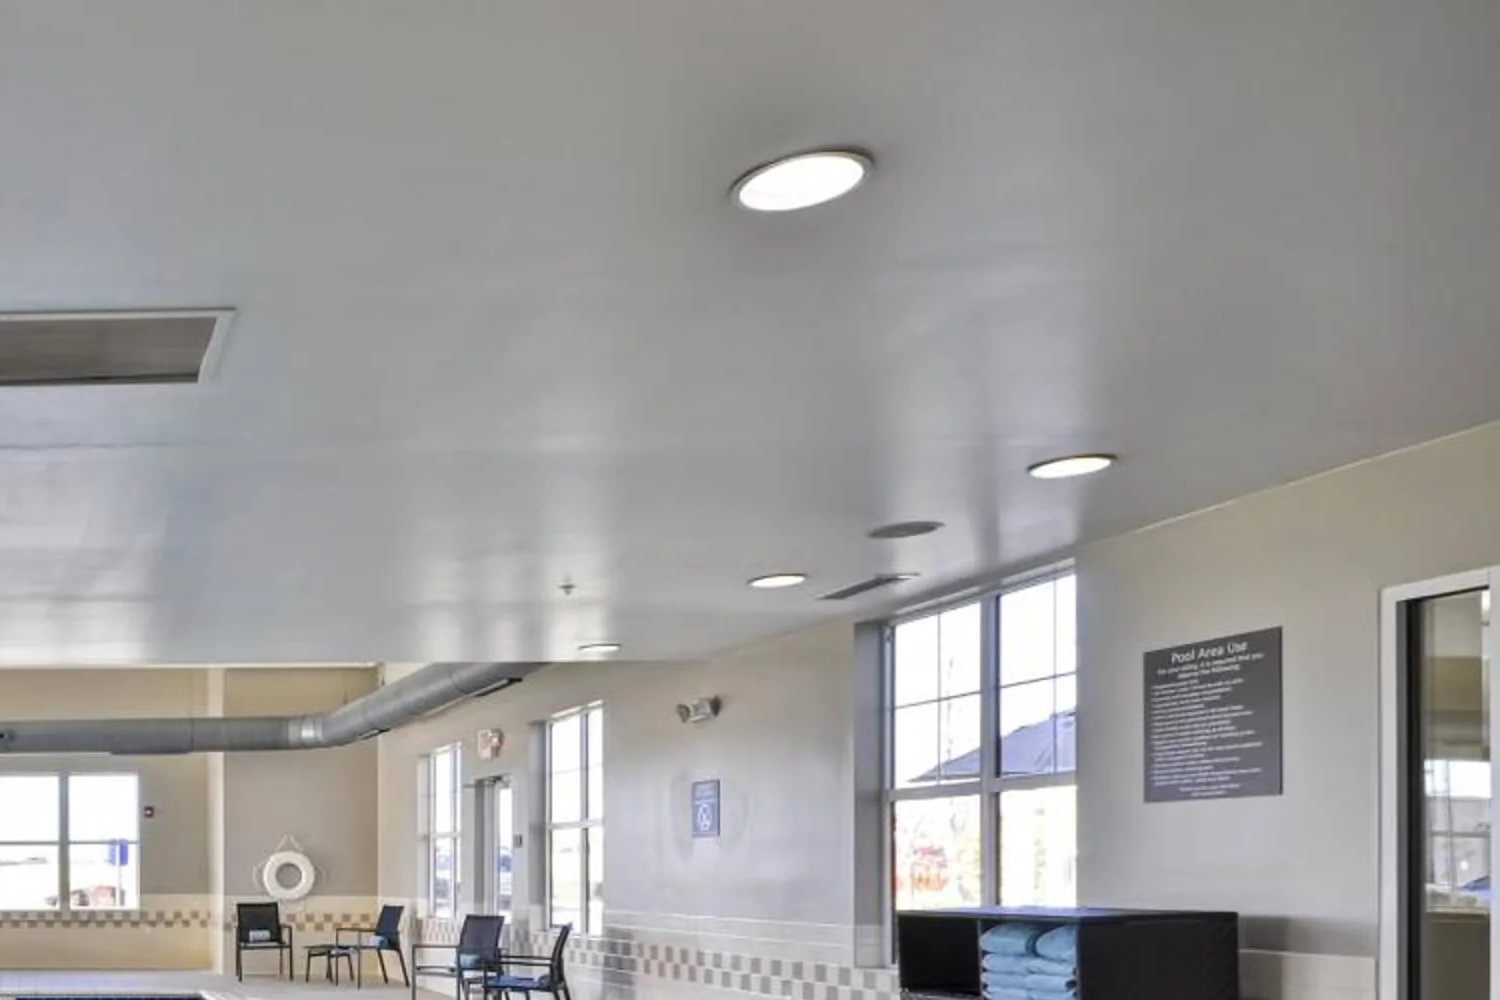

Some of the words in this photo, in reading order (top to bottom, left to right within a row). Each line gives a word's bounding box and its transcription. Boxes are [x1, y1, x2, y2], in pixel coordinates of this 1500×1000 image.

[1172, 649, 1195, 664] Pool
[1197, 646, 1224, 658] Area
[1227, 641, 1248, 654] Use
